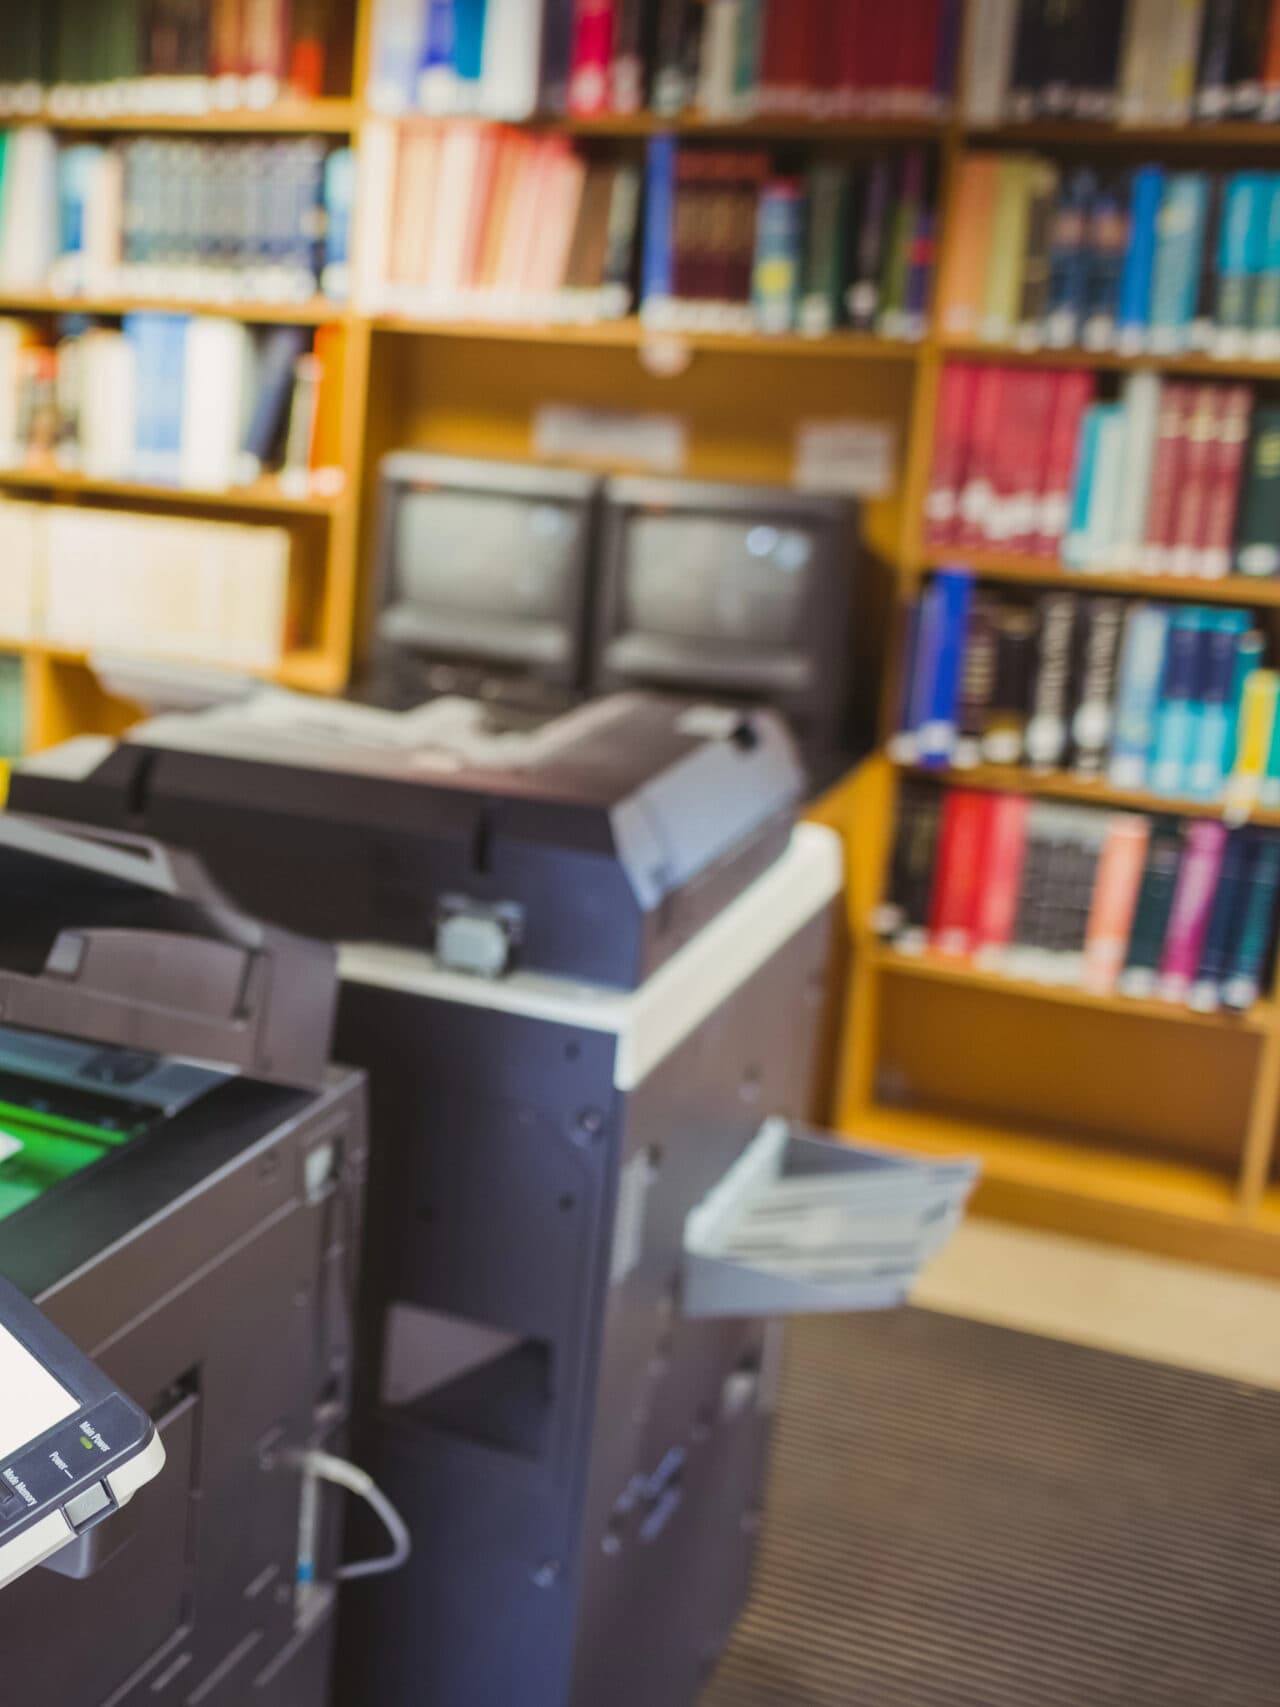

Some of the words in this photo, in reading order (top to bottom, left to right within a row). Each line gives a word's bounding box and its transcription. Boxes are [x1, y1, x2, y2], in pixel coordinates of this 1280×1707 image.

[79, 1421, 95, 1437] Main
[91, 1433, 111, 1452] Power
[48, 1451, 68, 1470] Power
[2, 1468, 19, 1486] Mode
[14, 1481, 38, 1507] Memory
